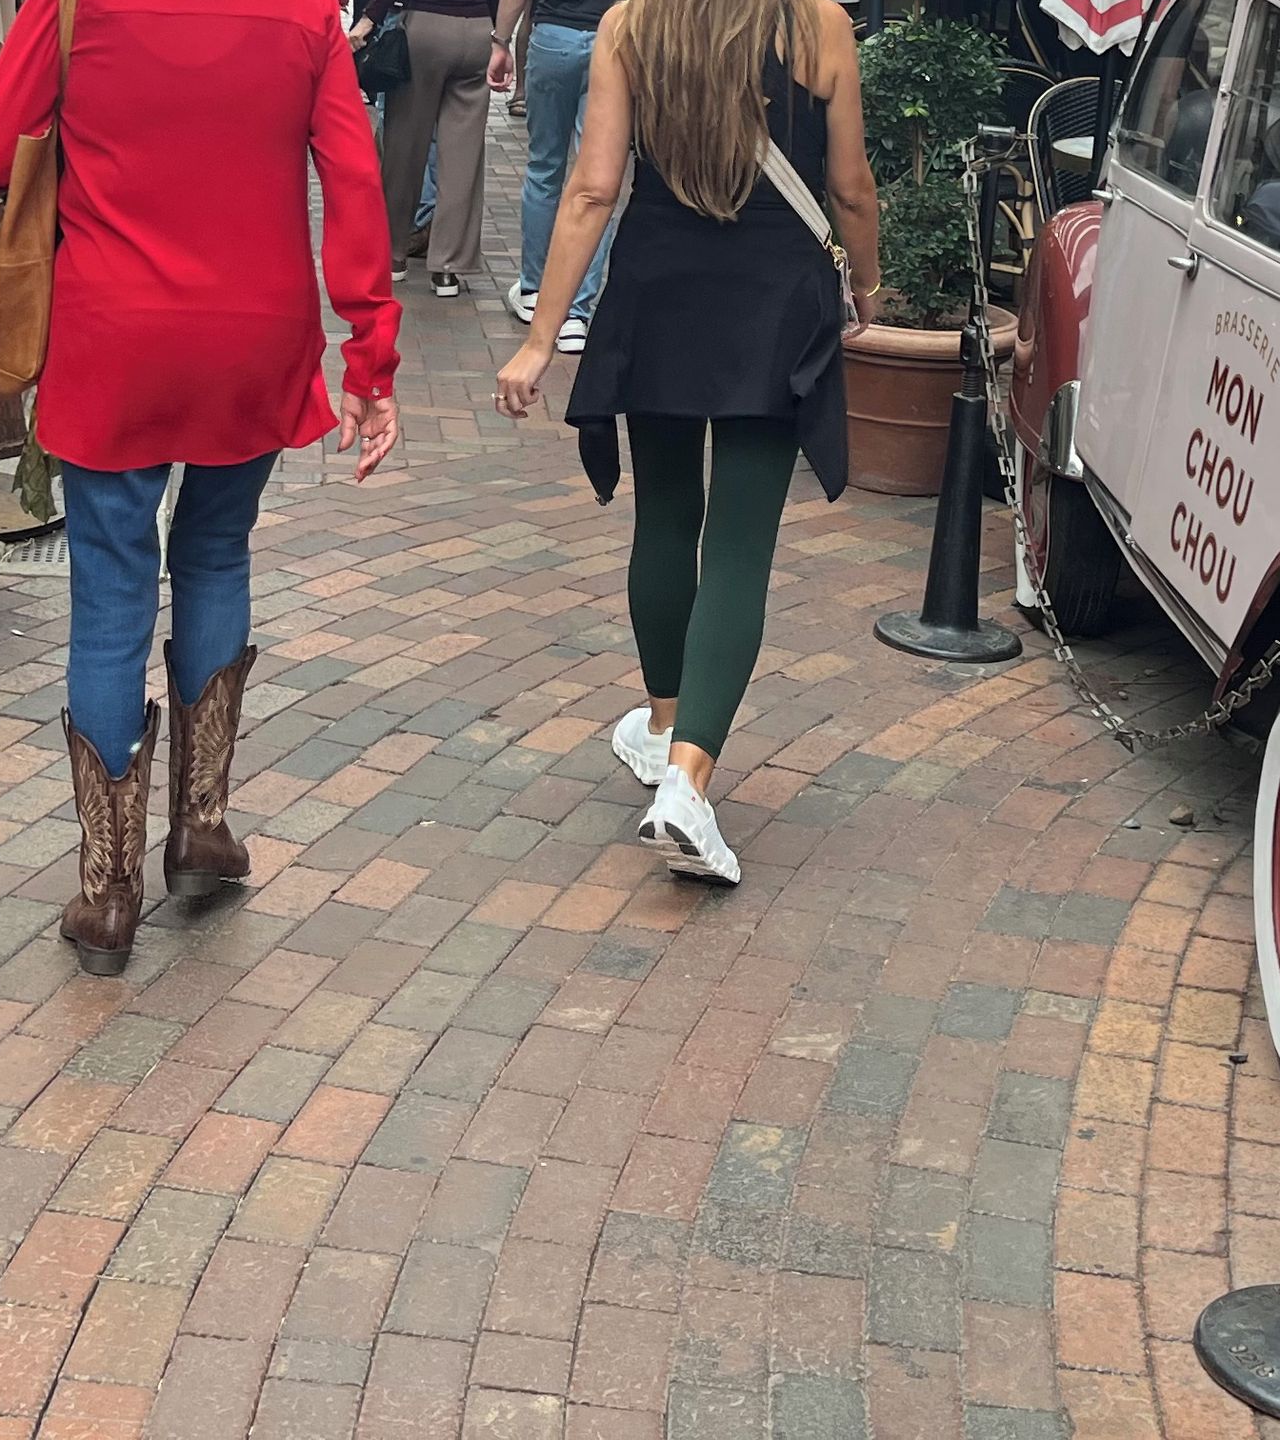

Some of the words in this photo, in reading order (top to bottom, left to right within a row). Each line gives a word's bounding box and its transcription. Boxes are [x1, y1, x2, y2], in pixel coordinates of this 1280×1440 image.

[1214, 311, 1280, 382] BRASSERIE
[1206, 356, 1264, 445] MON
[1185, 428, 1255, 526] CHOU
[1170, 502, 1237, 604] CHOU
